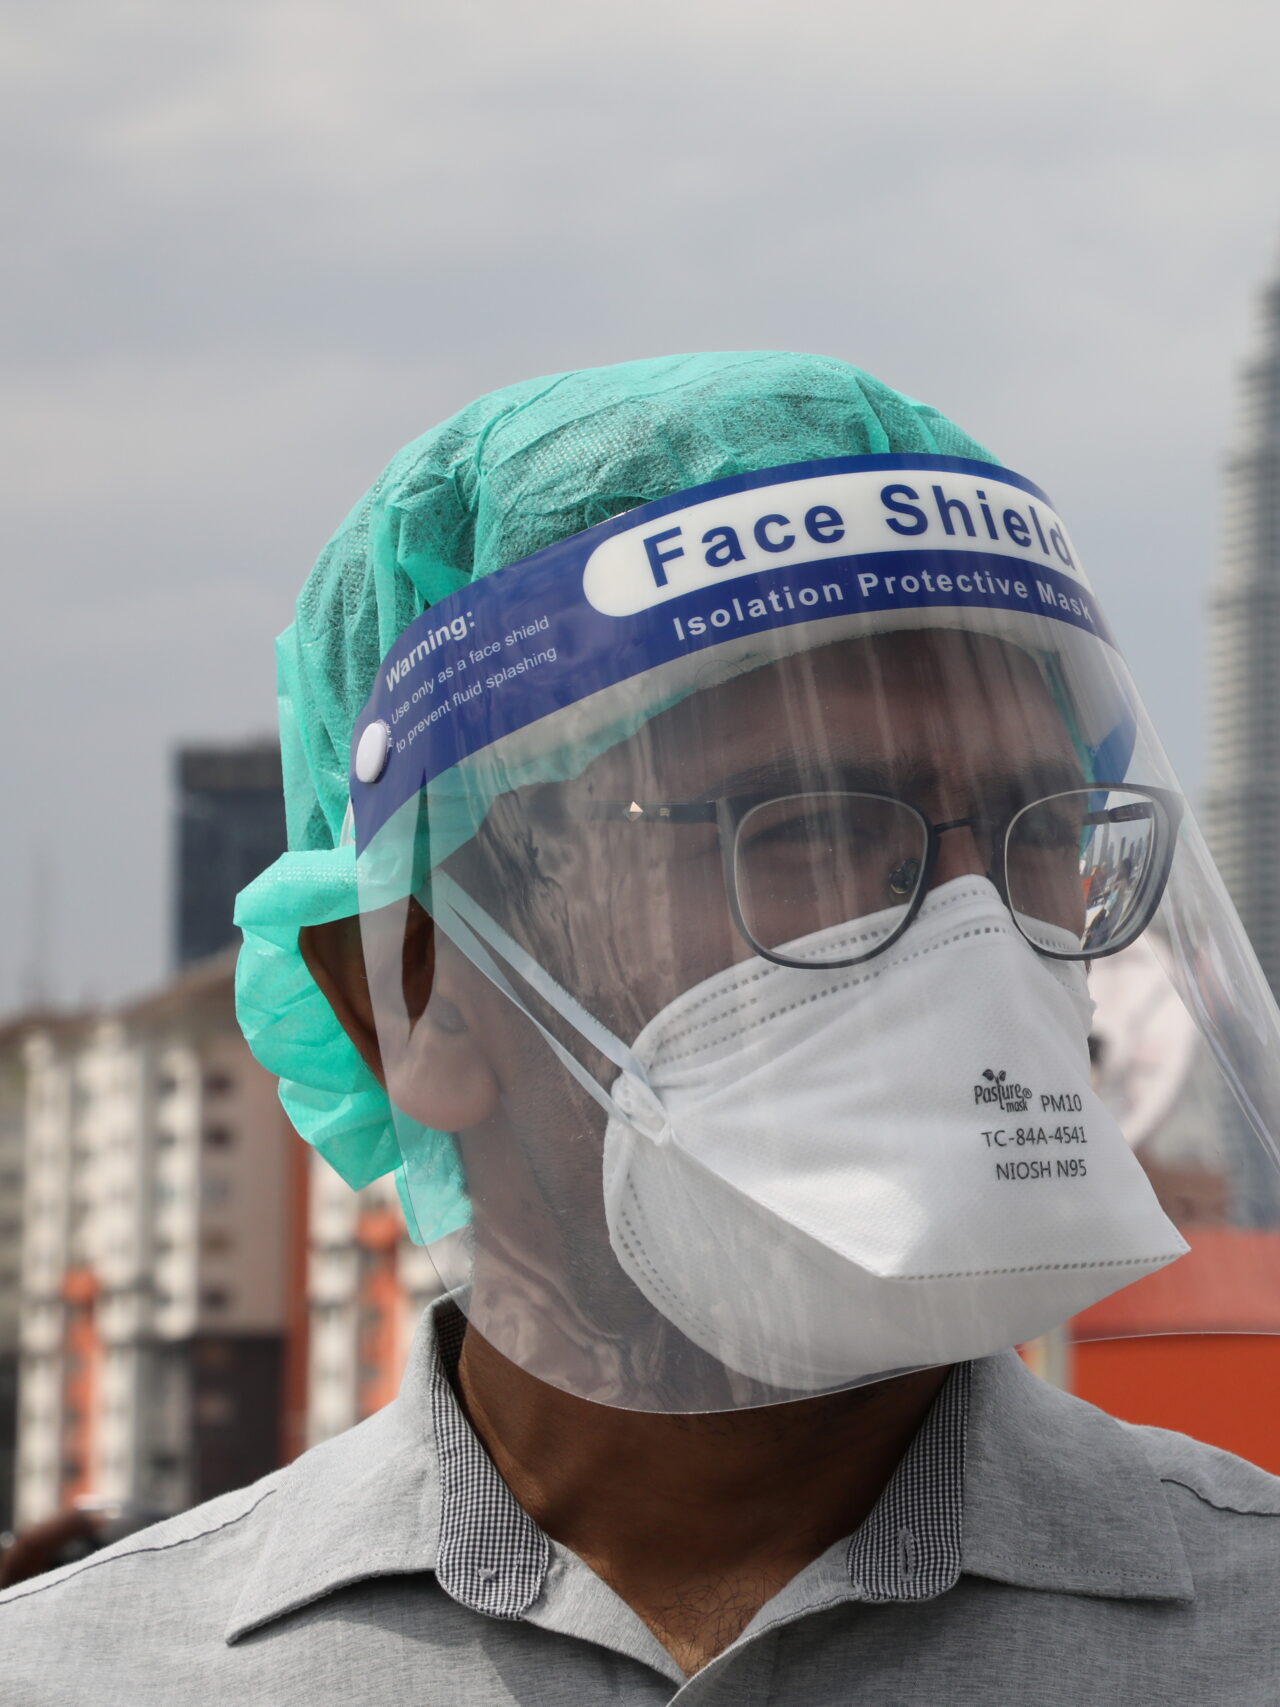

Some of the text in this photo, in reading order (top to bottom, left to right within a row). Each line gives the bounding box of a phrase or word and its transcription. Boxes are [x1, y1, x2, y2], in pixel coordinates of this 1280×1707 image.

[642, 483, 1077, 588] Face Shield
[673, 571, 1093, 641] Isolation Protective Mask
[385, 611, 476, 692] Warning:
[391, 616, 550, 725] Use only as a face shield
[396, 647, 558, 753] to prevent fluid splashing
[981, 1126, 1087, 1147] TC-84A-4541
[1006, 1099, 1029, 1112] mask
[1040, 1094, 1082, 1112] PM10
[996, 1159, 1087, 1181] NIOSH N95
